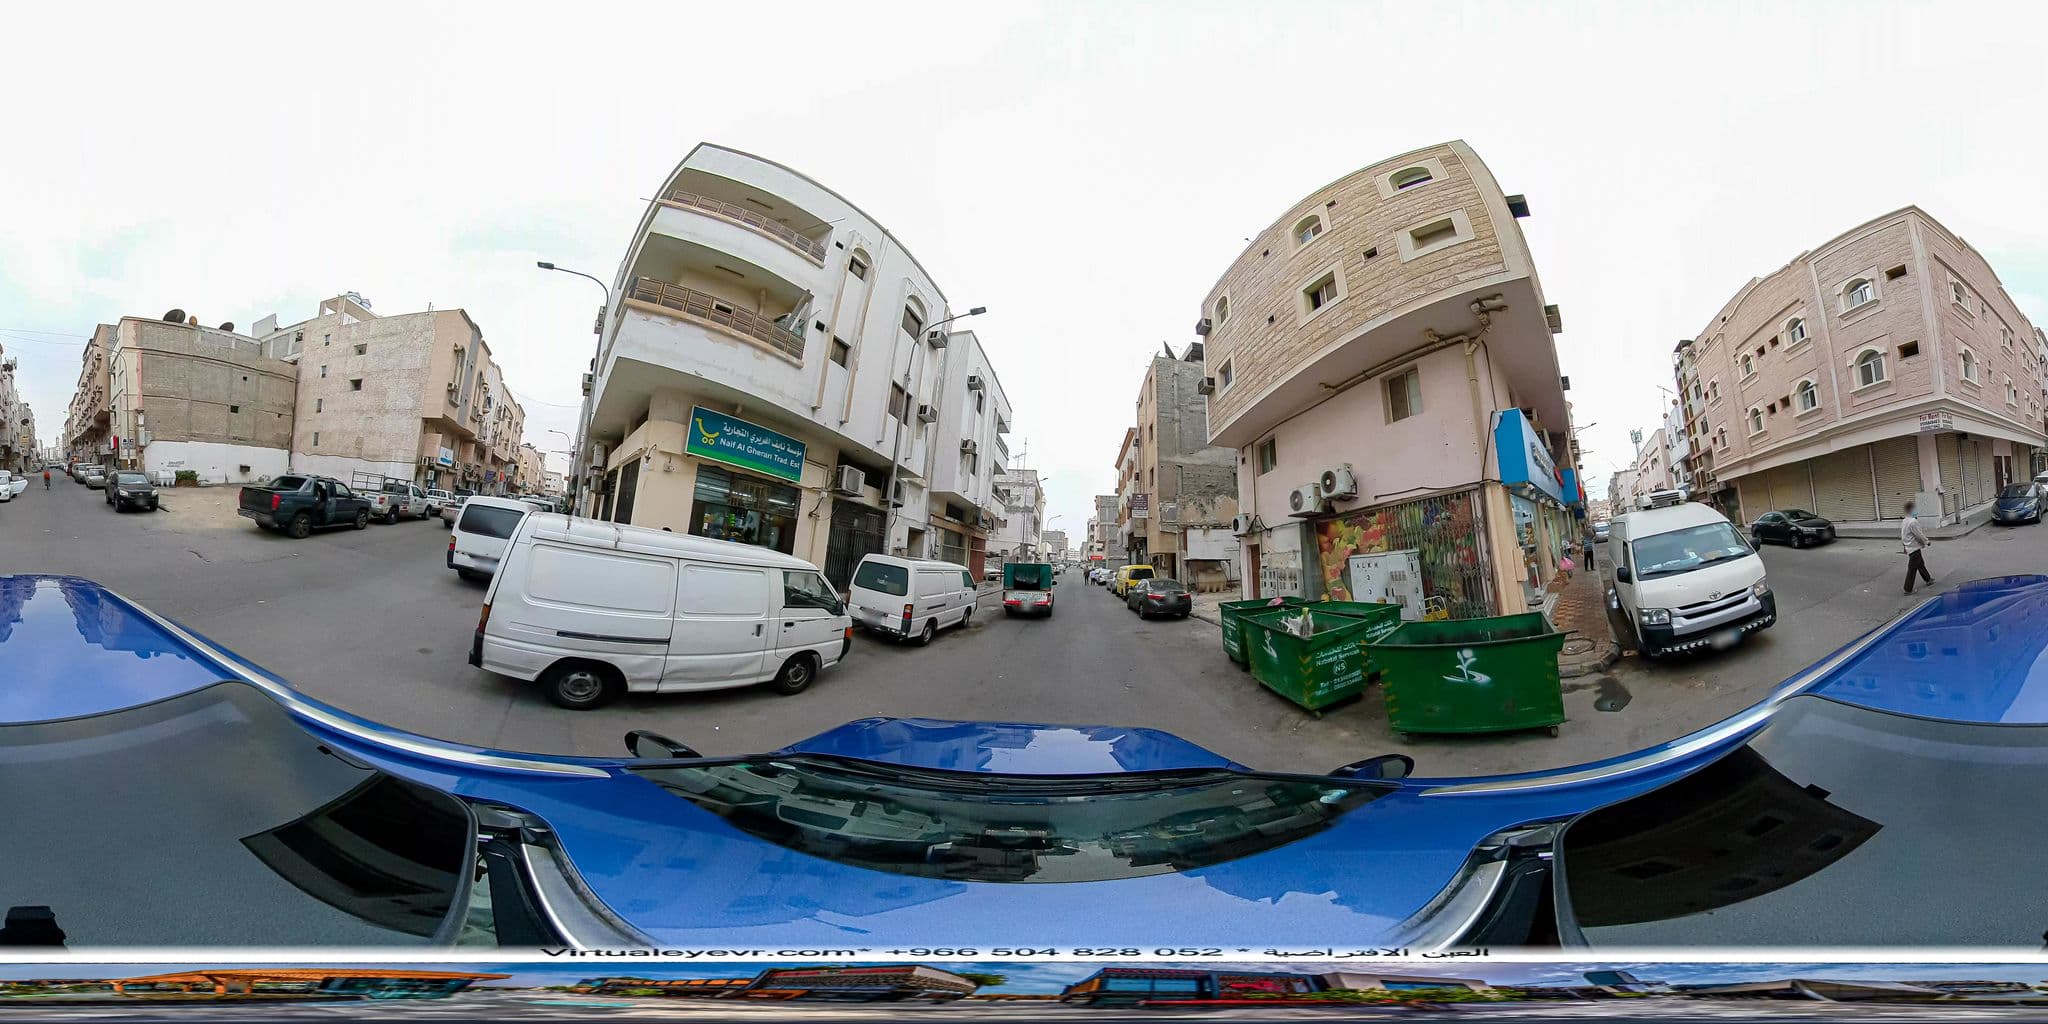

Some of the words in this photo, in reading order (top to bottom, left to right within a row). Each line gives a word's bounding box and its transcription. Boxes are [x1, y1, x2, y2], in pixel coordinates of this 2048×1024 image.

[723, 422, 749, 437] التجارية
[719, 438, 736, 448] Naif
[736, 442, 745, 451] Al
[1335, 662, 1346, 673] NS
